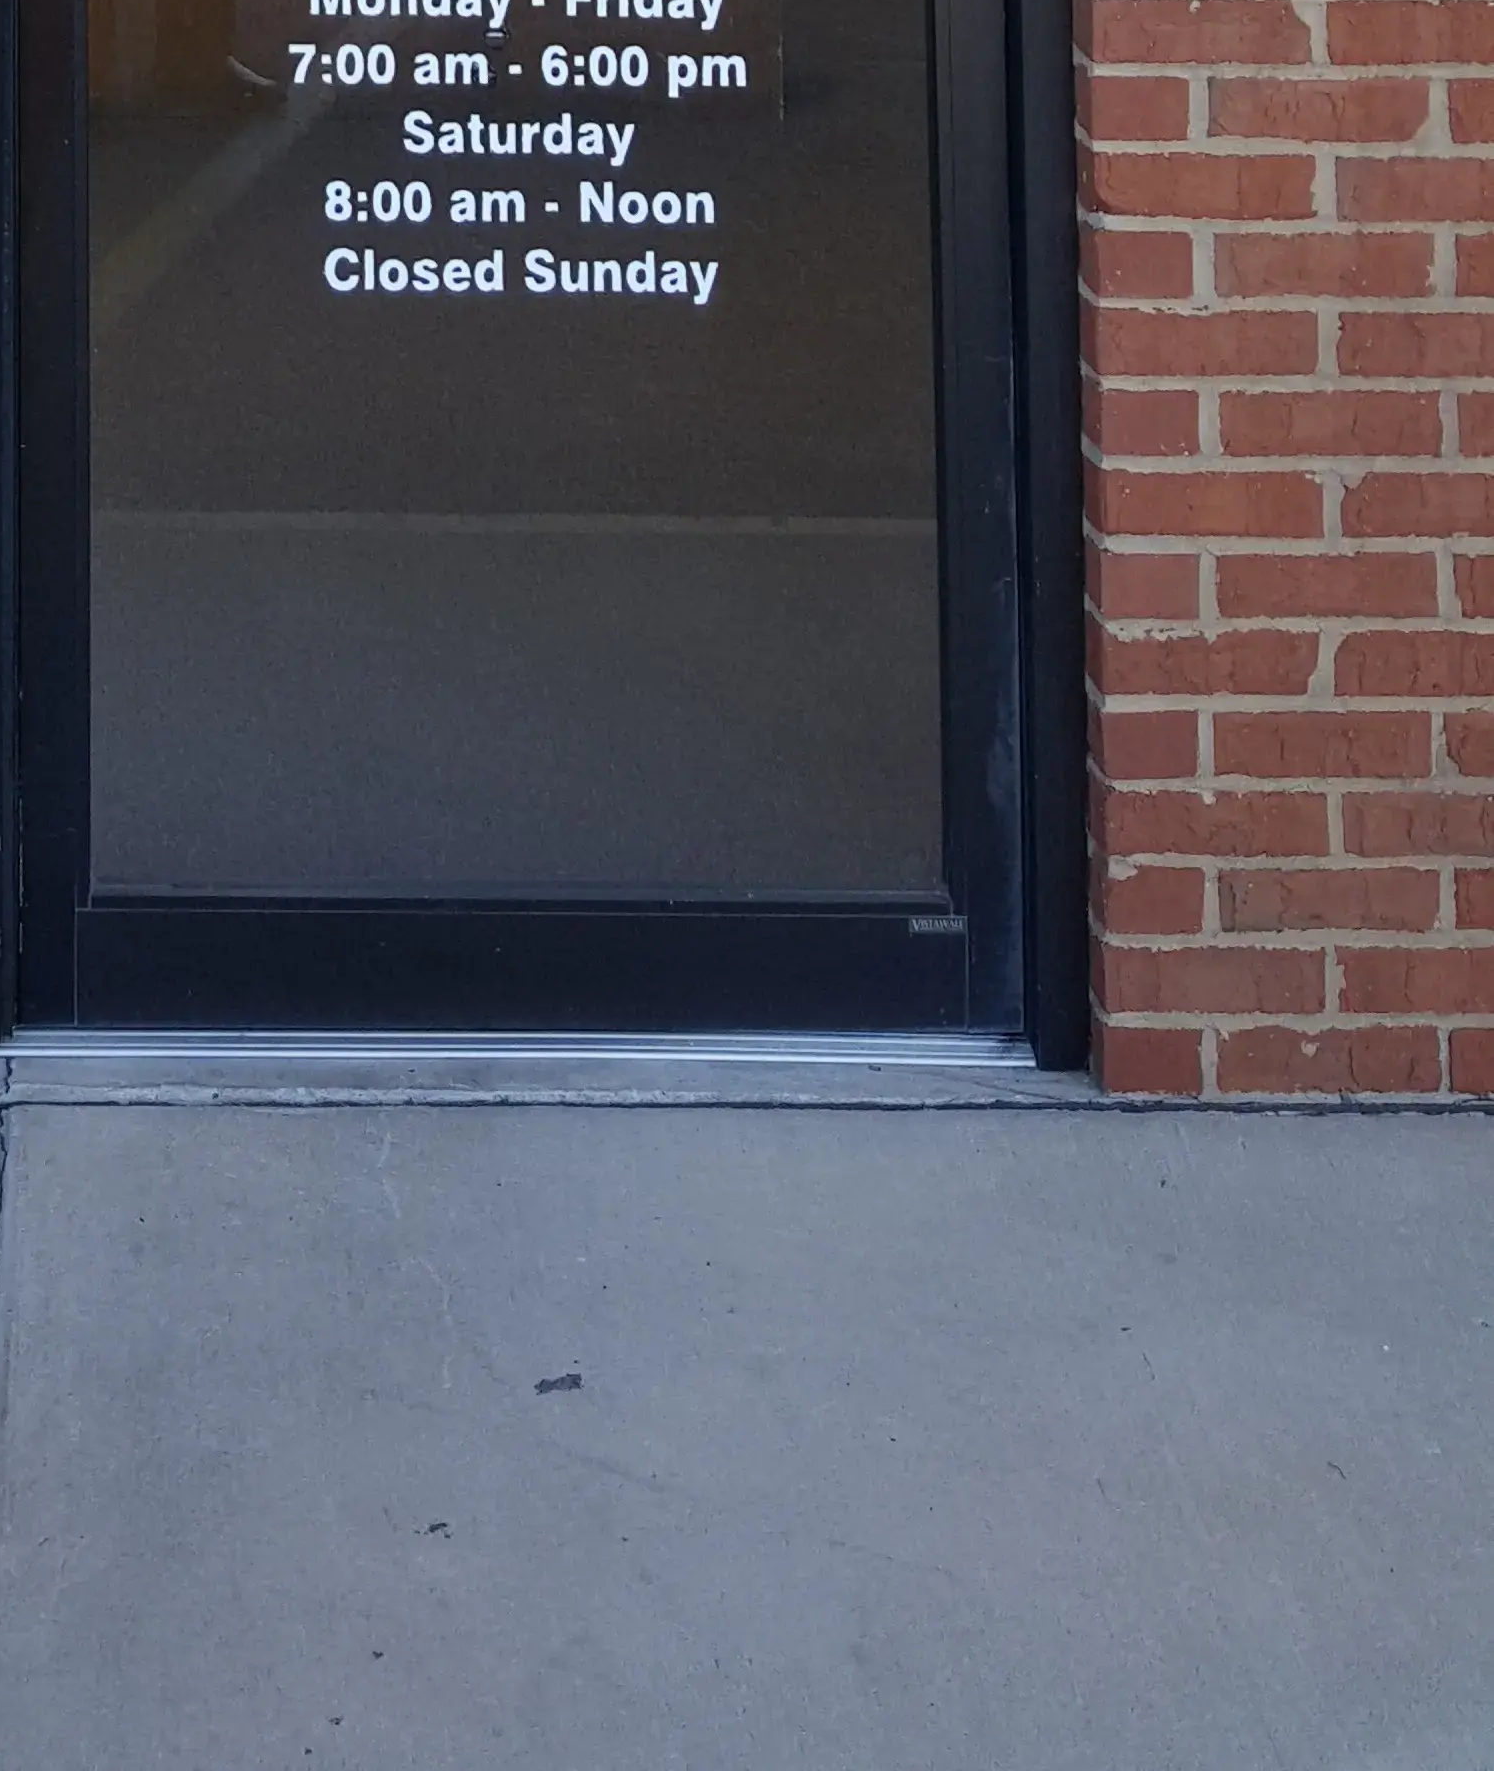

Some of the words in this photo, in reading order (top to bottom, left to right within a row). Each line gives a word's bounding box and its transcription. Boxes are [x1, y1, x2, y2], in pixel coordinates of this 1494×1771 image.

[288, 44, 396, 85] 7:00
[413, 53, 489, 85] am
[541, 45, 649, 87] 6:00
[667, 55, 747, 98] pm
[403, 110, 635, 166] Saturday
[324, 180, 433, 223] 8:00
[450, 189, 526, 223] am
[579, 181, 716, 224] Noon
[324, 248, 504, 292] Closed
[524, 249, 719, 305] Sunday
